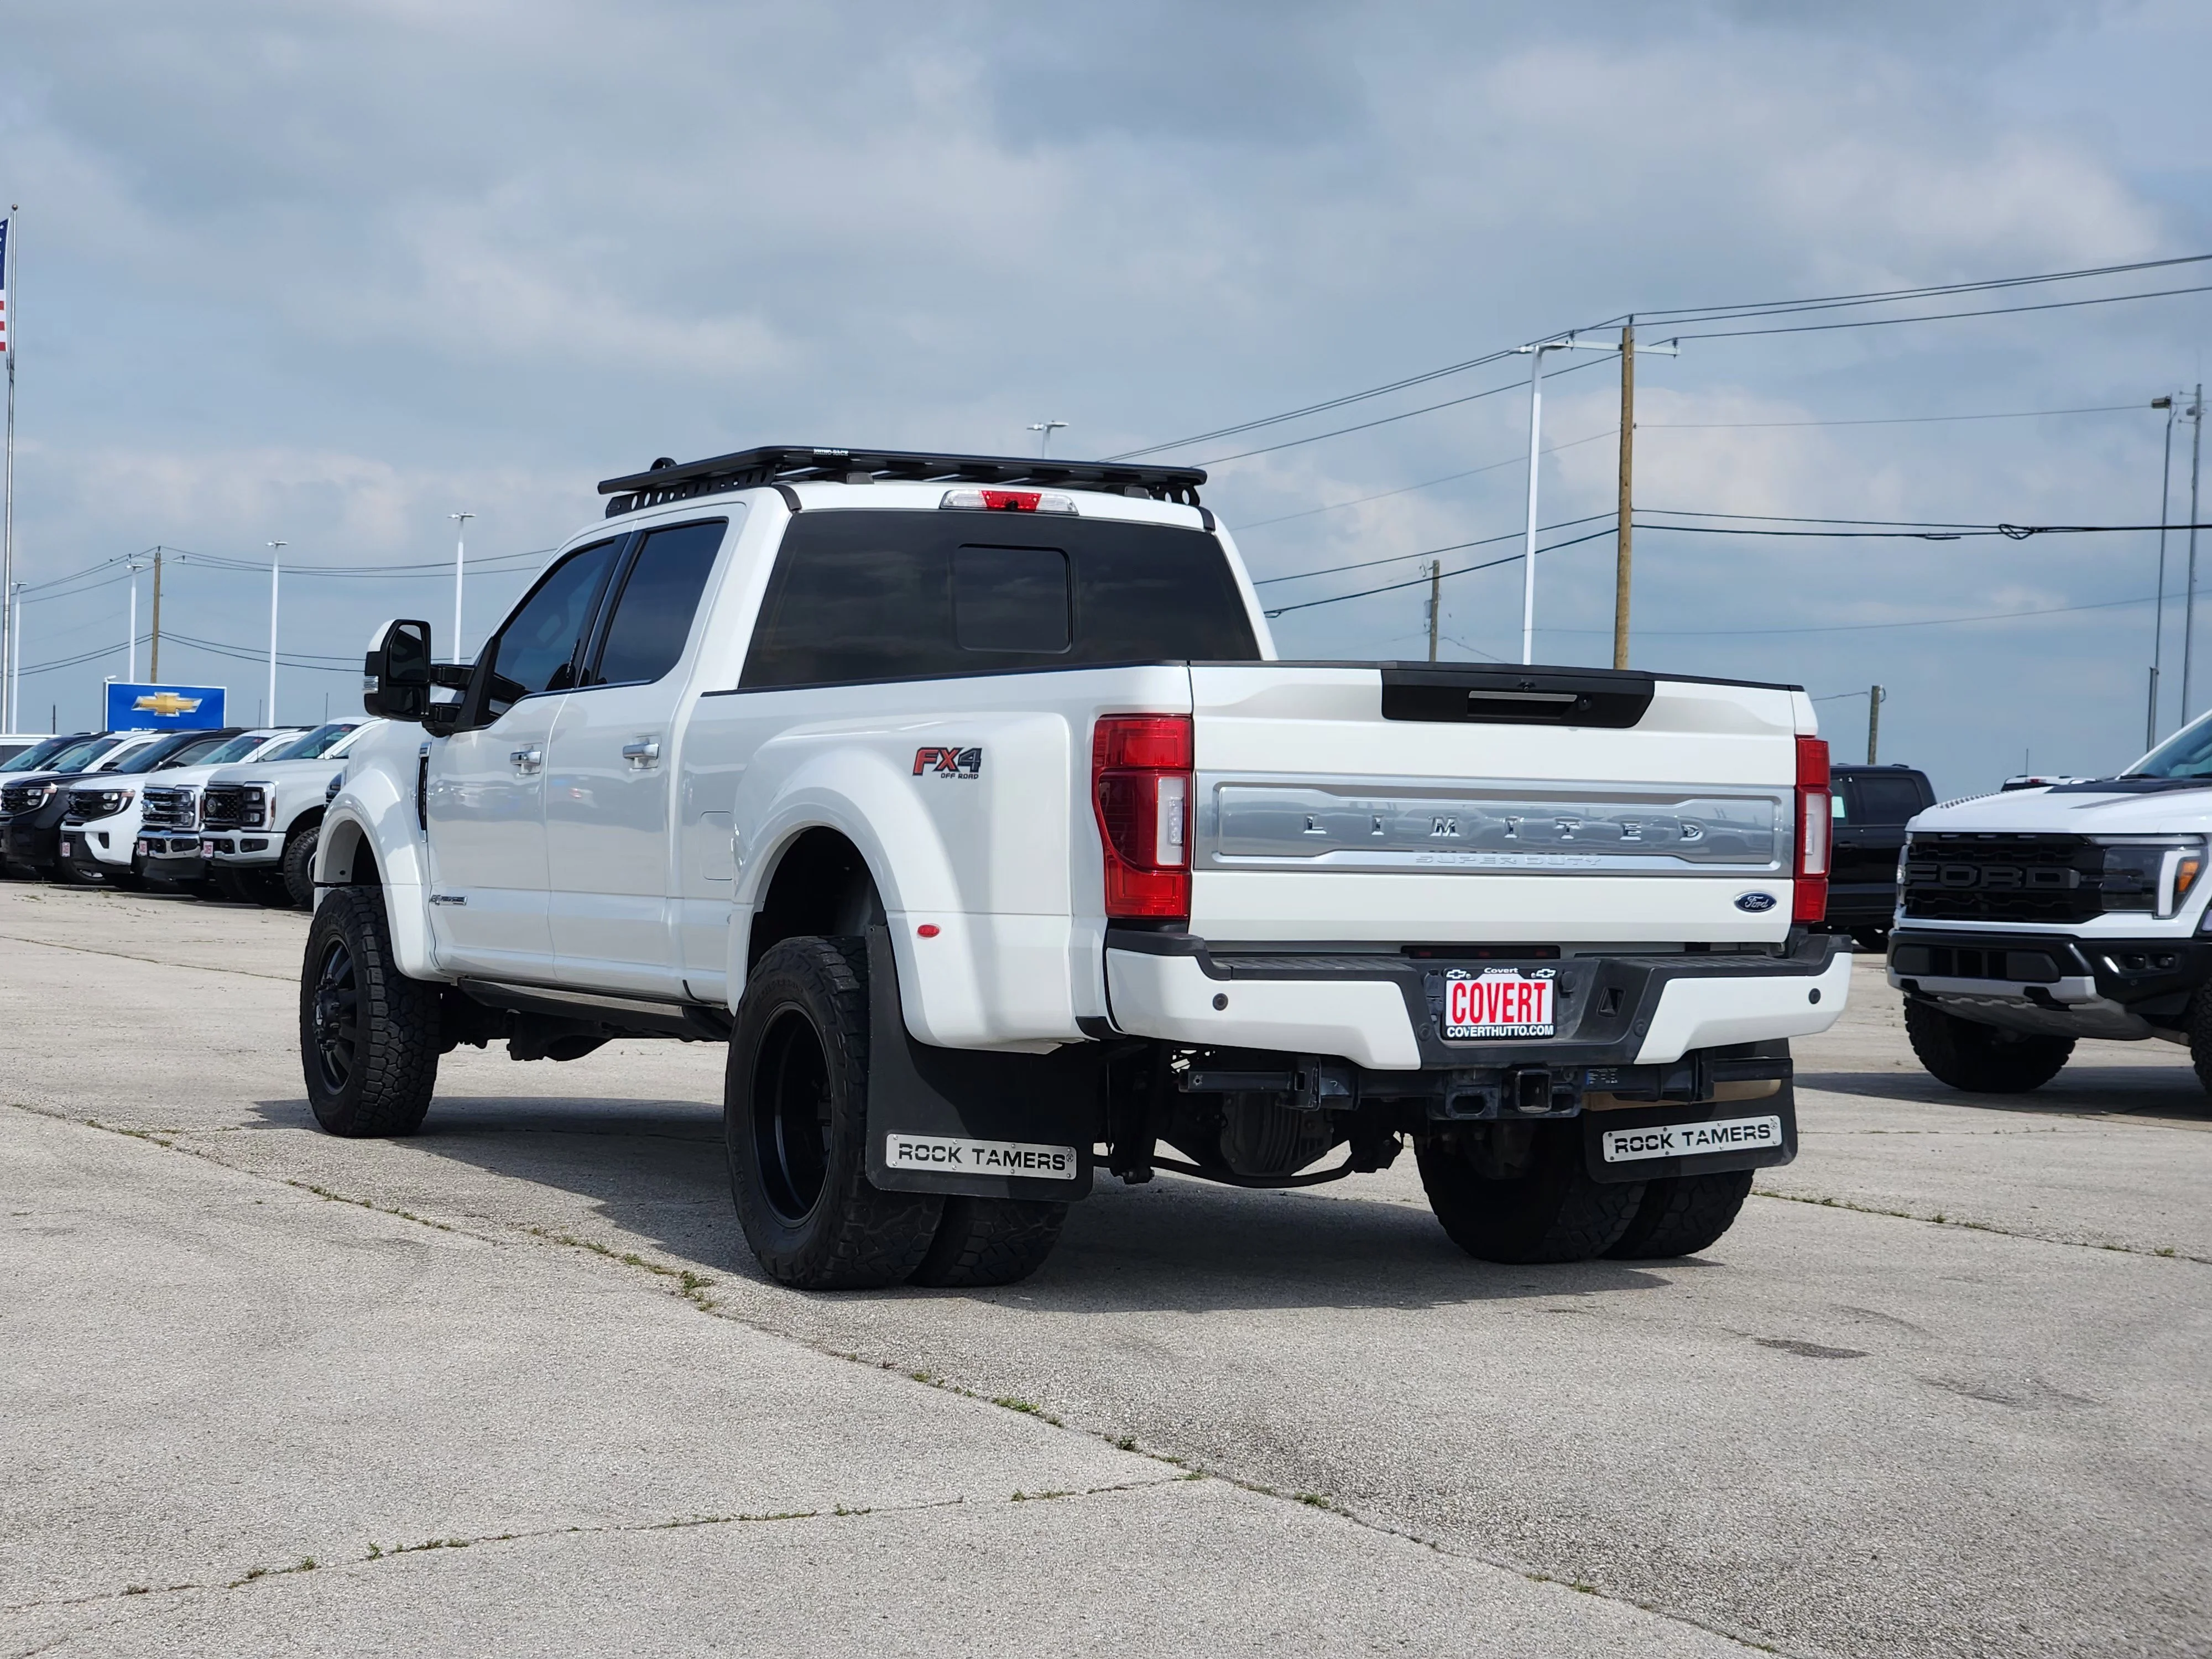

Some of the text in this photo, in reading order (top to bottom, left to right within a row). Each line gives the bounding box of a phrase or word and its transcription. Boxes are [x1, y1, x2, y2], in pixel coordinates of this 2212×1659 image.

[912, 747, 983, 776] FX4
[1303, 815, 1703, 841] LIMITED
[1416, 855, 1601, 865] SUPER DUTY
[1905, 863, 2081, 889] FORD
[1745, 896, 1770, 908] Ford
[1452, 982, 1546, 1024] COVERT
[1447, 1025, 1554, 1038] COVERTHUTTO.COM
[899, 1142, 963, 1164] ROCK
[1615, 1133, 1675, 1154] ROCK
